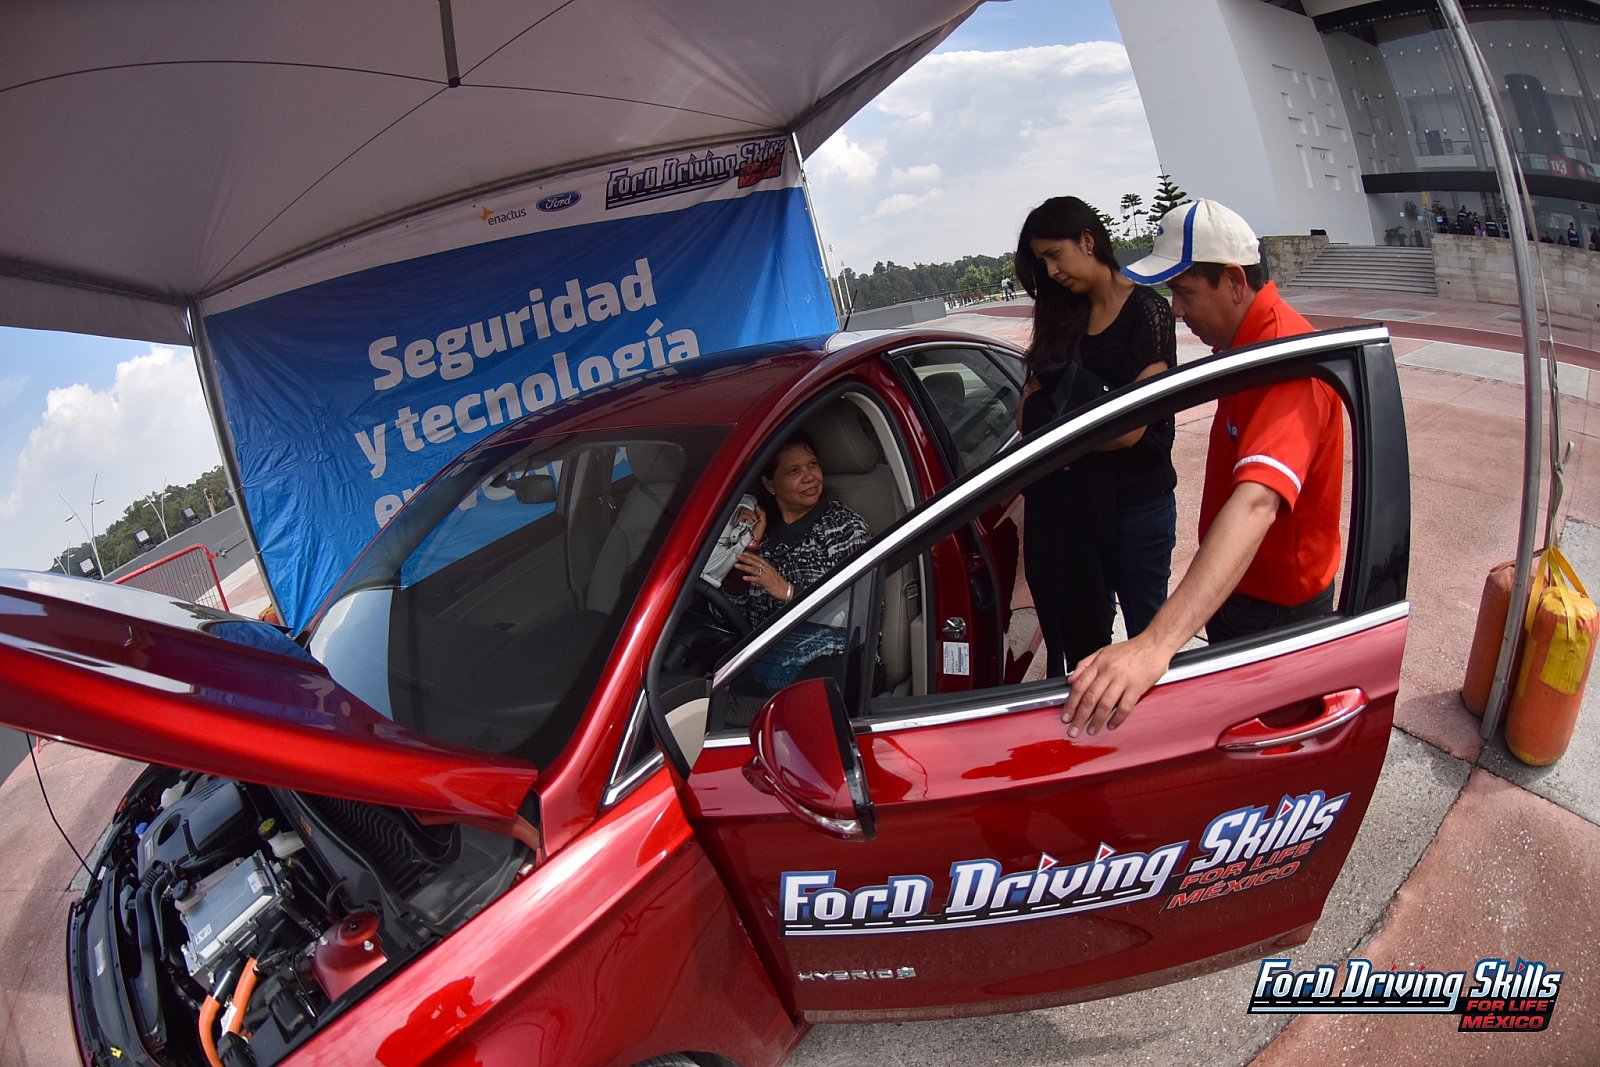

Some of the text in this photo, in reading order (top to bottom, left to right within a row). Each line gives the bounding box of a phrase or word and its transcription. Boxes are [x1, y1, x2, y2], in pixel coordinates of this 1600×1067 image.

[662, 150, 738, 184] Driving
[487, 208, 527, 226] enactus
[545, 194, 572, 210] Ford
[368, 257, 657, 391] Seguridad
[354, 318, 700, 479] y tecnología
[945, 841, 1188, 914] Driving
[1190, 793, 1347, 872] Skills
[1179, 841, 1313, 890] FOR LIFE
[1167, 860, 1301, 910] MÉXICO
